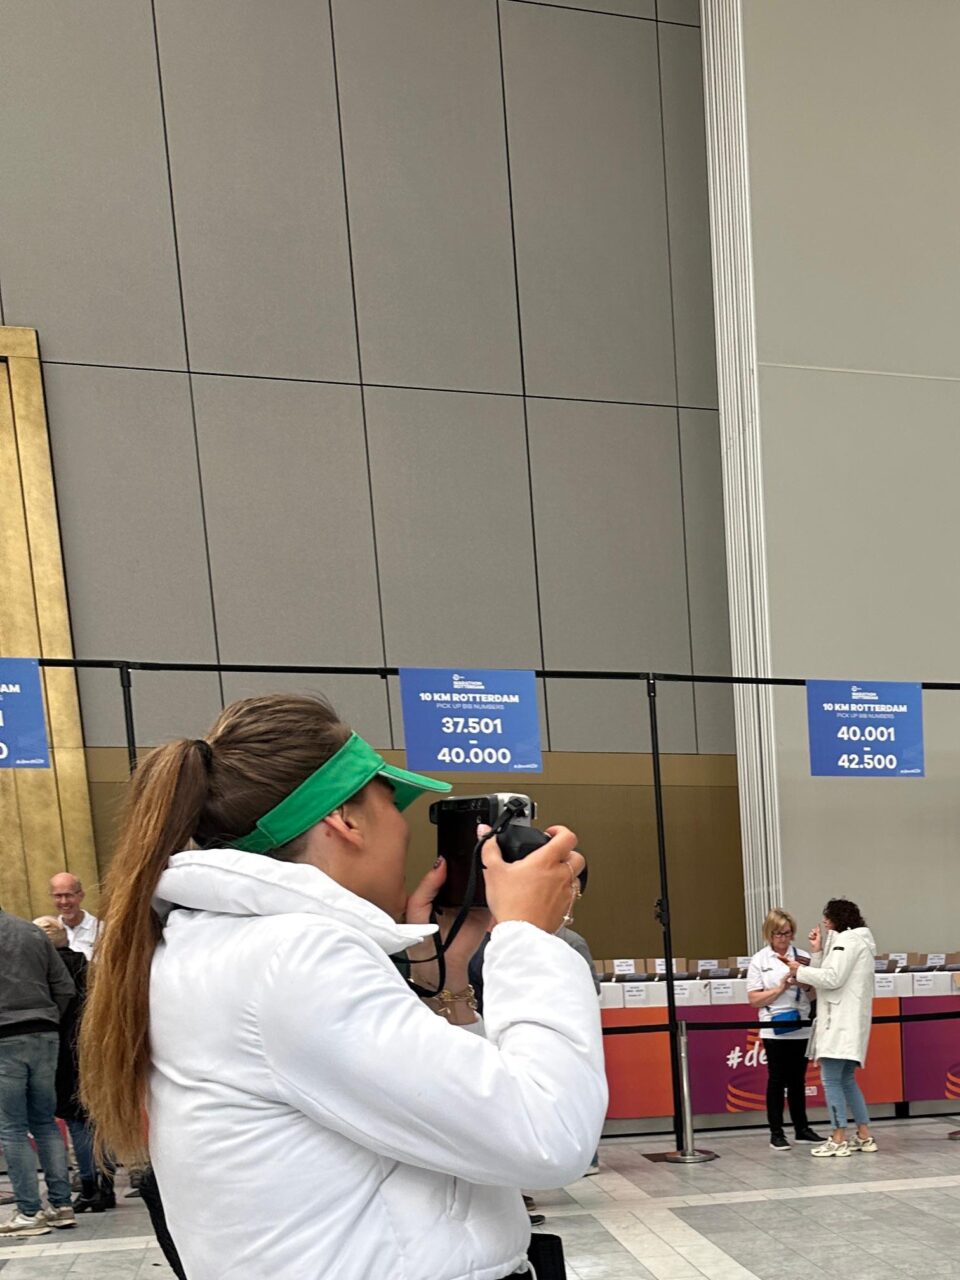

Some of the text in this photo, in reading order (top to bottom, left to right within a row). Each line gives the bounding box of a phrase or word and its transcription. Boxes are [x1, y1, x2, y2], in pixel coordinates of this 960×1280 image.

[0, 684, 21, 693] AM
[419, 692, 520, 703] 10 KM ROTTERDAM
[822, 703, 834, 711] 10
[850, 704, 908, 712] ROTTERDAM
[441, 717, 502, 734] 37.501
[837, 726, 895, 741] 40.001
[437, 747, 511, 764] 40.000
[838, 754, 897, 769] 42.500
[726, 1041, 768, 1069] #de
